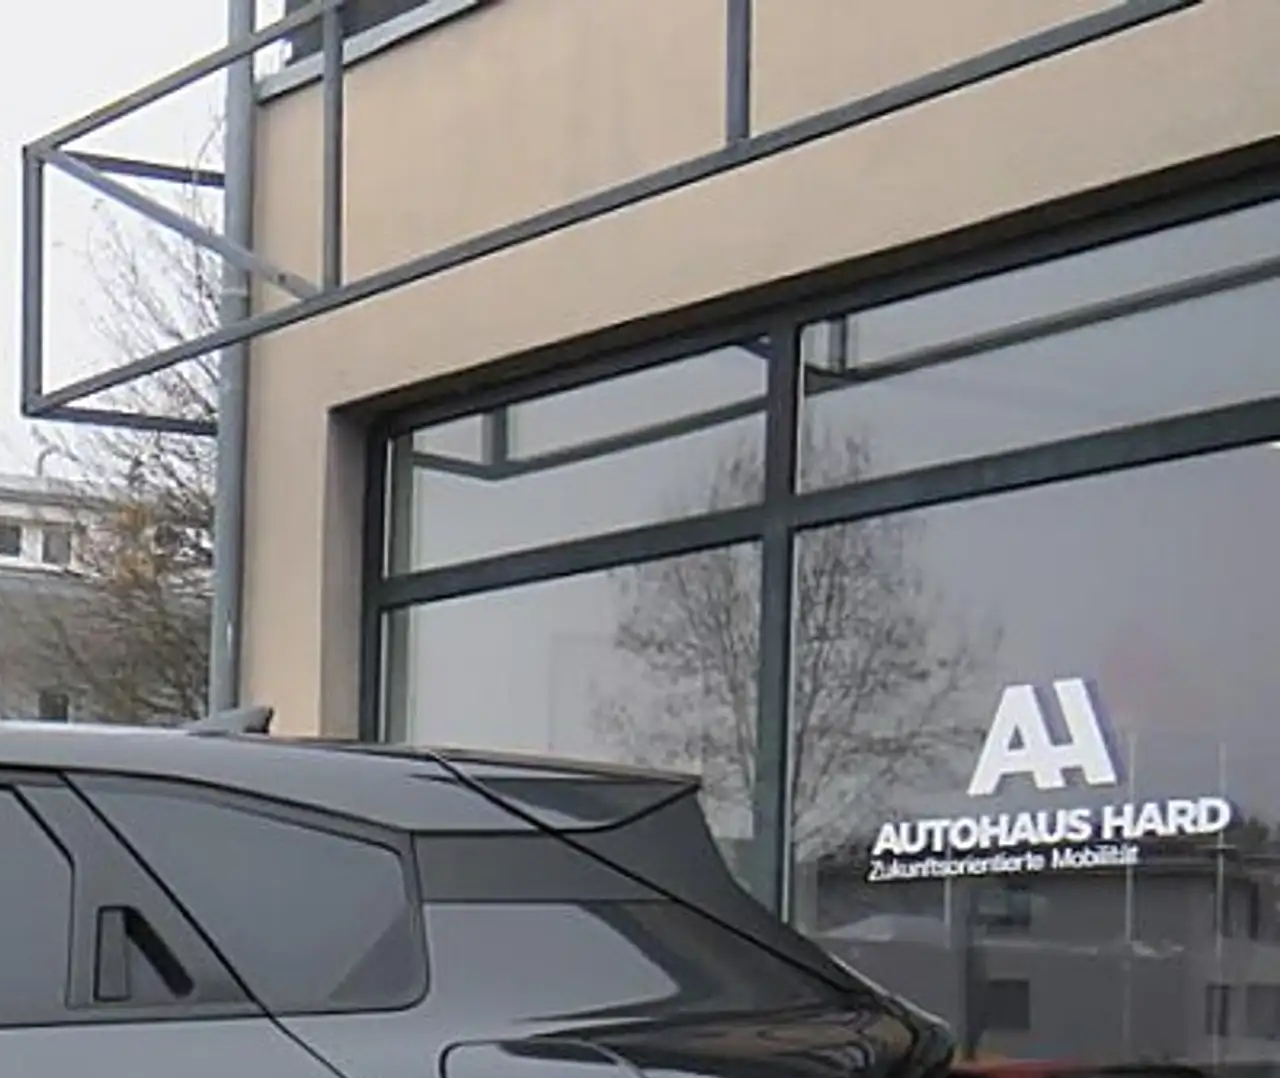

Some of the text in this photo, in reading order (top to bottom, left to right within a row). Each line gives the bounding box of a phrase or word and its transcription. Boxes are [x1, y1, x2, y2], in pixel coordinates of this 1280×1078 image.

[873, 796, 1231, 856] AUTOHAUS HARD
[868, 851, 1045, 881] Zukunftsorientierte
